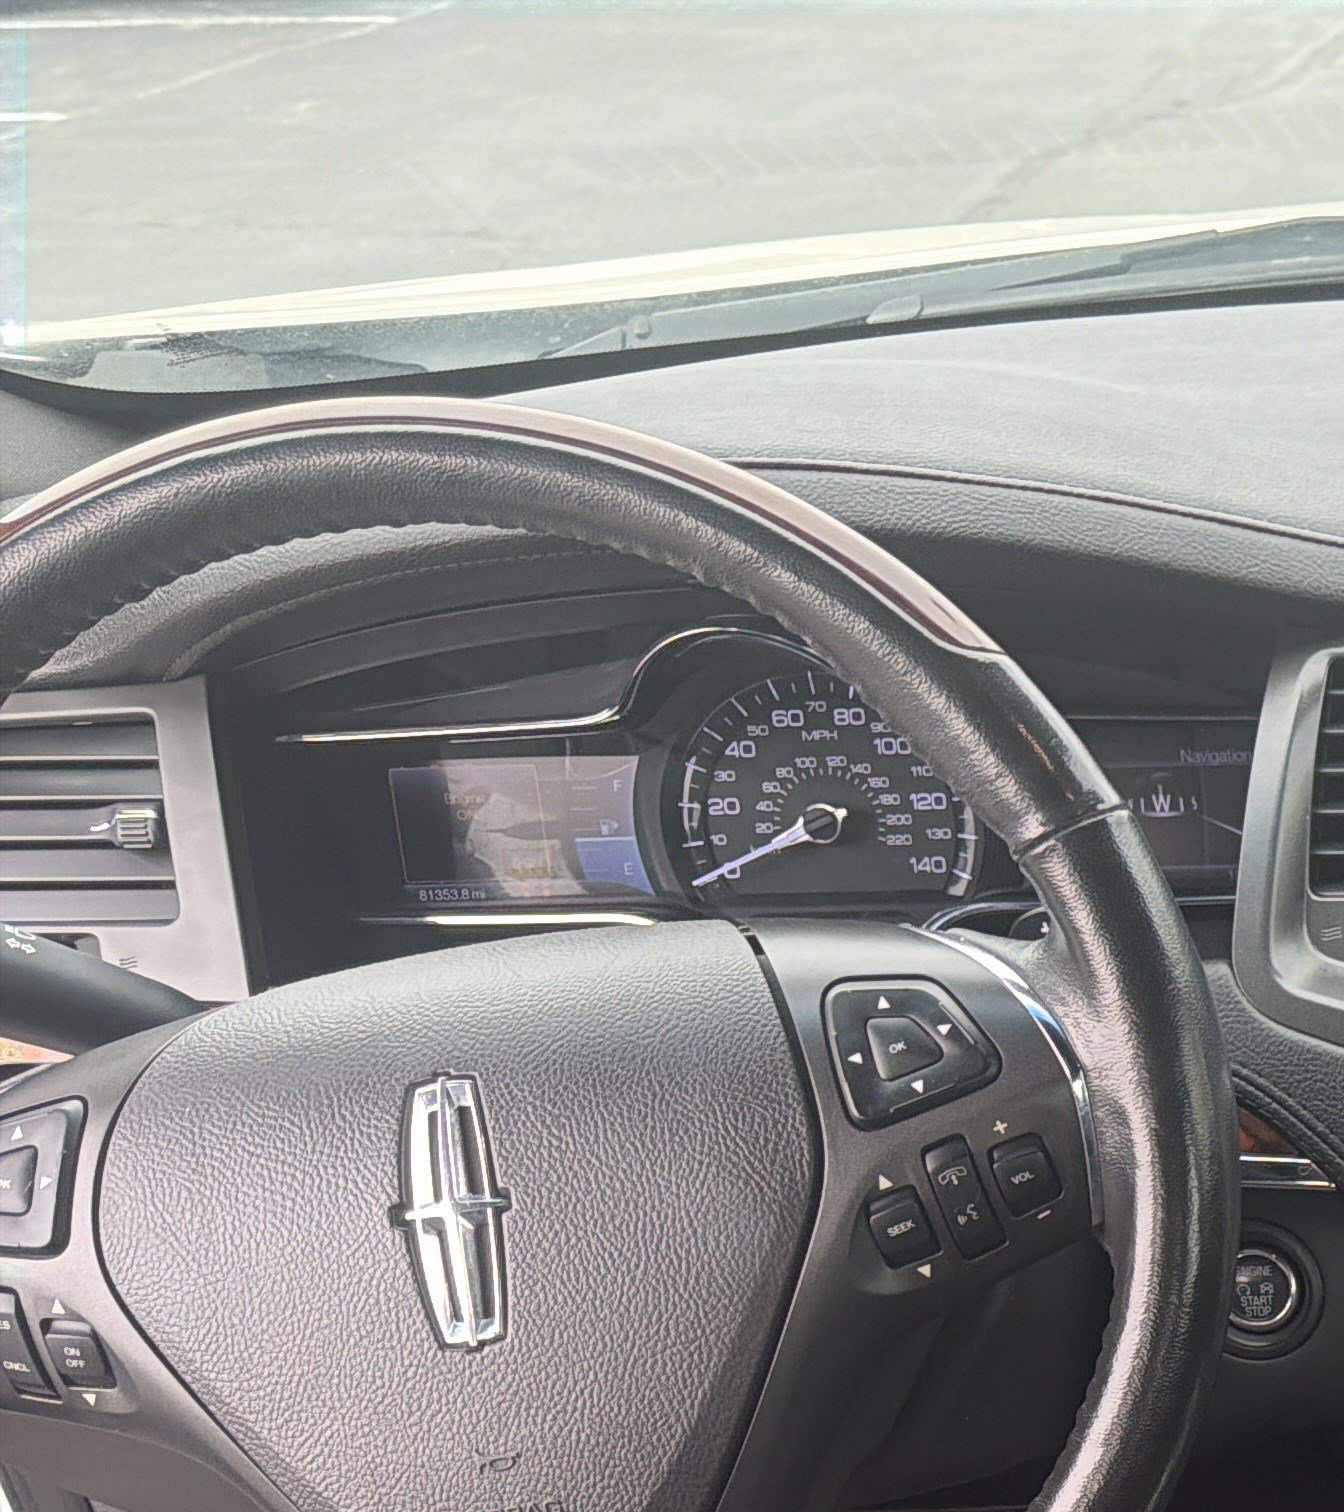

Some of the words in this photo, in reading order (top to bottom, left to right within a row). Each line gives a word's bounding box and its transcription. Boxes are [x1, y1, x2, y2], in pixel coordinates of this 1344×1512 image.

[805, 700, 827, 712] 70
[771, 709, 804, 727] 60
[833, 707, 866, 726] 80
[747, 724, 769, 737] 50
[802, 729, 838, 741] MPH
[725, 740, 756, 758] 40
[873, 737, 912, 755] 100
[795, 757, 817, 768] 100
[714, 770, 736, 781] 30
[776, 767, 794, 779] 80
[911, 766, 934, 777] 110
[762, 781, 780, 794] 60
[707, 797, 740, 815] 20
[756, 800, 773, 812] 40
[909, 792, 947, 810] 120
[755, 822, 773, 834] 20
[926, 827, 951, 839] 130
[710, 834, 727, 846] 10
[909, 856, 947, 874] 140
[419, 889, 470, 901] 81353.8
[888, 1041, 908, 1054] OK
[1010, 1170, 1035, 1185] VOL
[886, 1219, 915, 1237] SEEK
[1240, 1295, 1274, 1307] START
[1245, 1306, 1272, 1317] STOP
